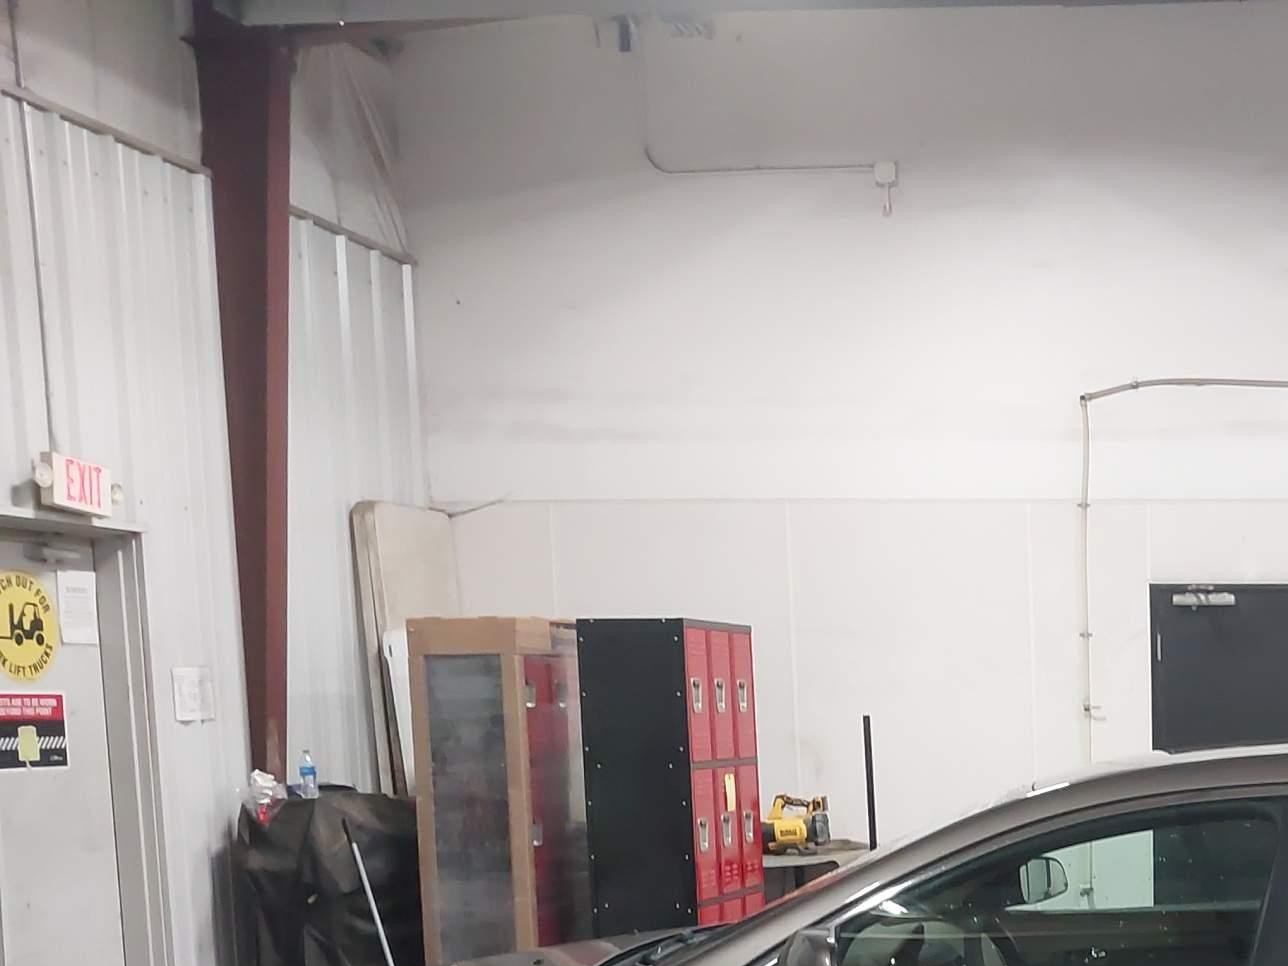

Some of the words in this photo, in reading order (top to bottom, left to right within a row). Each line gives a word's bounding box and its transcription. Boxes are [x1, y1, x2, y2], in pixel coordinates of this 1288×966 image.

[65, 458, 102, 508] EXIT
[15, 575, 34, 591] OUT
[34, 588, 51, 613] FOR
[9, 663, 26, 677] LIFT
[28, 643, 53, 677] TRUCKS
